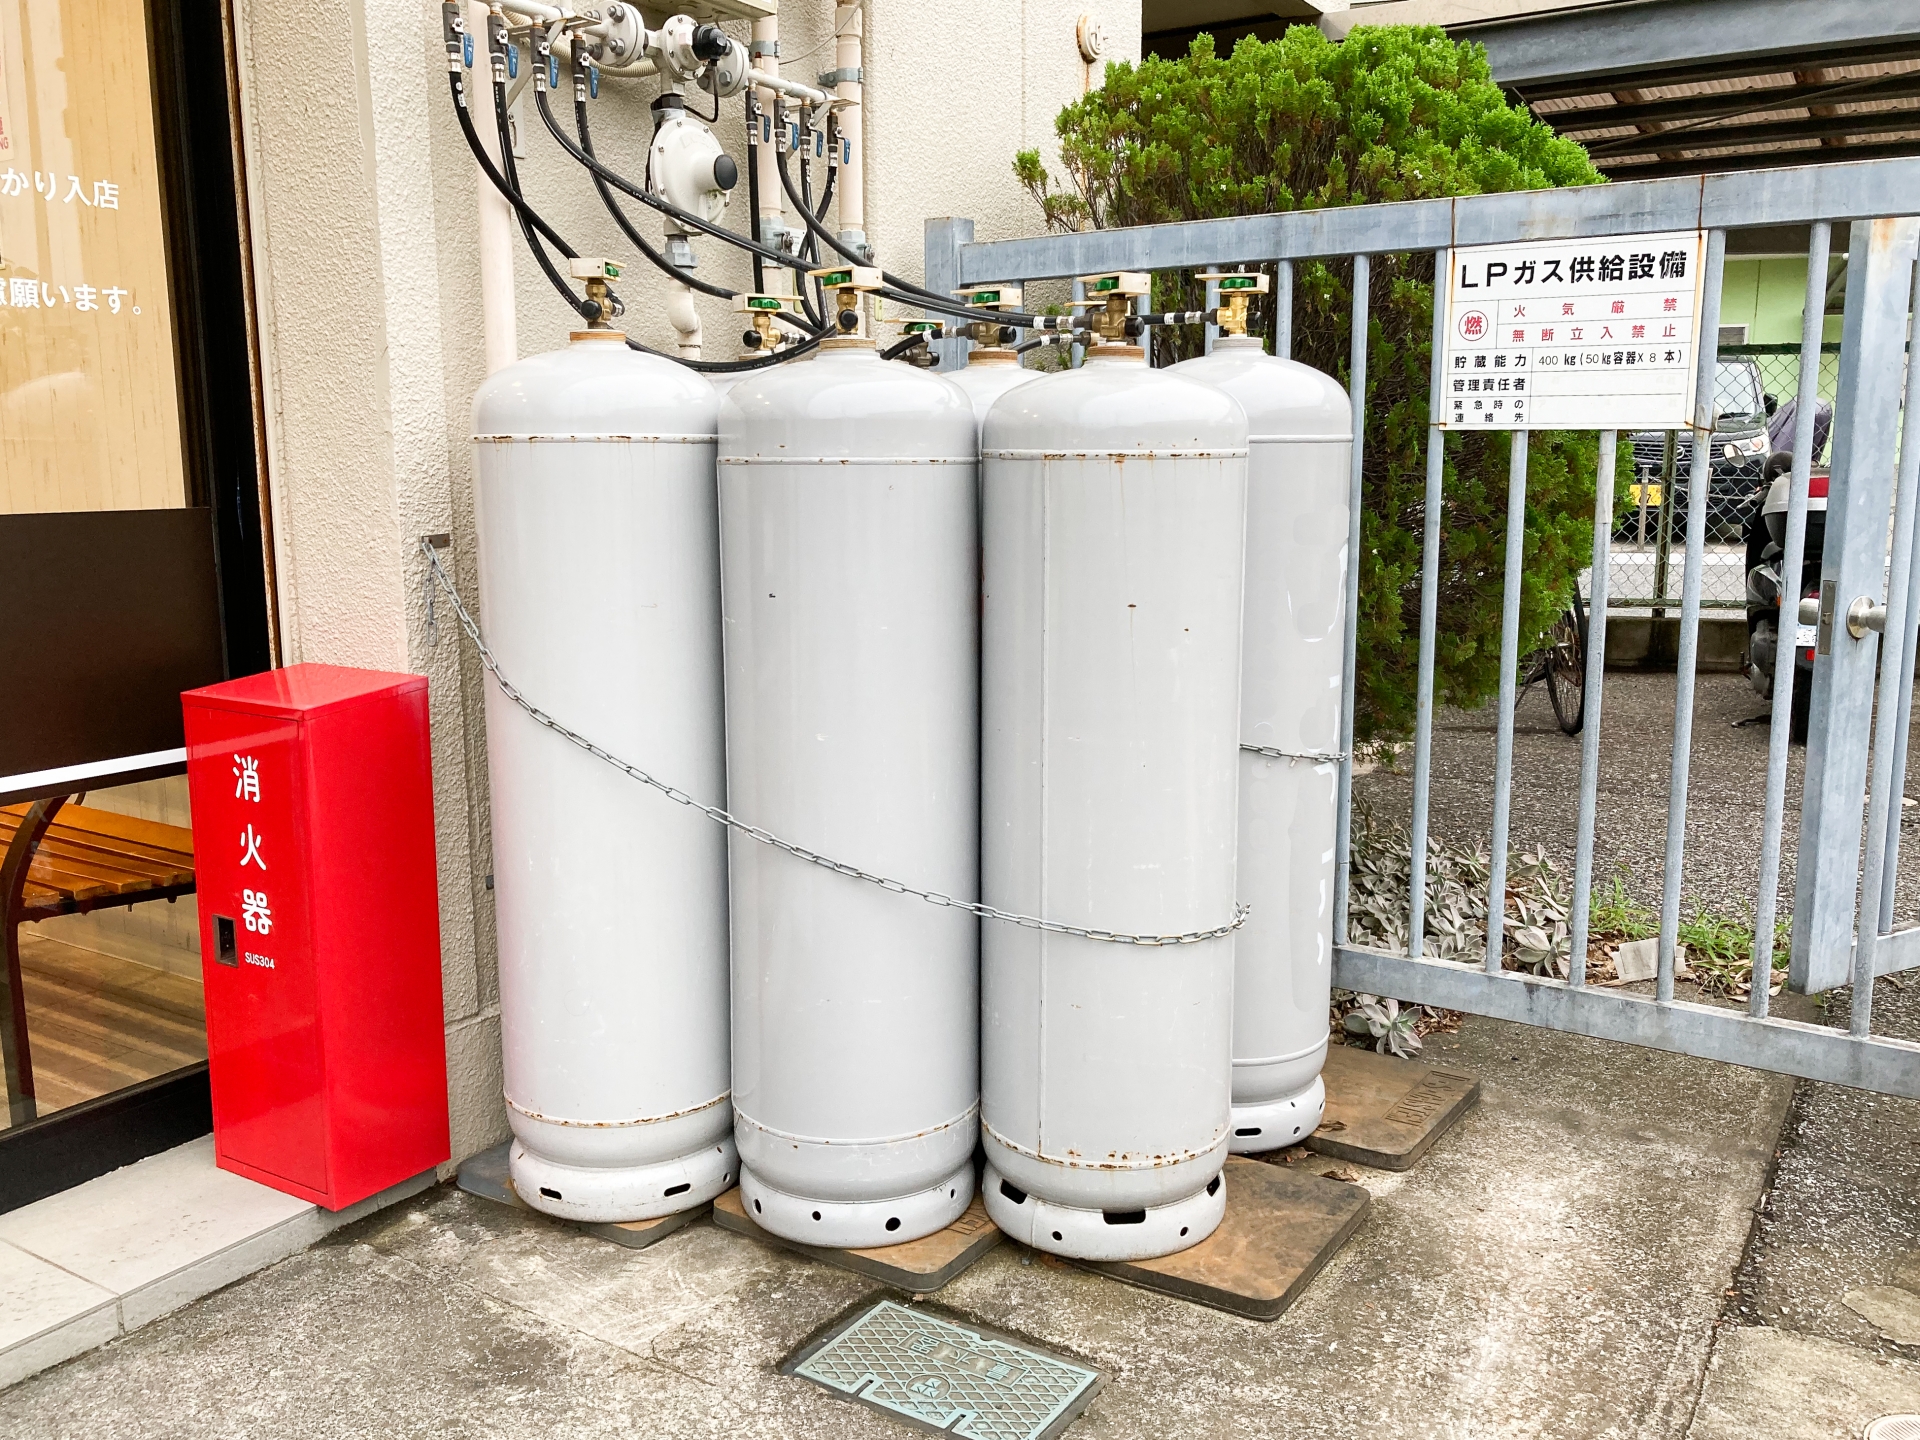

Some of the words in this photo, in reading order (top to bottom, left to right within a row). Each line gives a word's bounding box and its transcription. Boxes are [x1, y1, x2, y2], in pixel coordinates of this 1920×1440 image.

[1461, 250, 1687, 288] LPガス供給設備
[0, 277, 142, 316] 願います。
[1513, 298, 1678, 318] 火気厳禁
[1464, 315, 1483, 336] 燃
[1512, 324, 1676, 343] 無断立入禁止
[1454, 353, 1527, 369] 貯蔵能力
[1453, 377, 1526, 392] 管理責任者
[1454, 399, 1524, 410] 緊急時の
[1454, 412, 1524, 422] 連絡先
[232, 754, 272, 935] 消火器
[245, 952, 275, 969] SUS304
